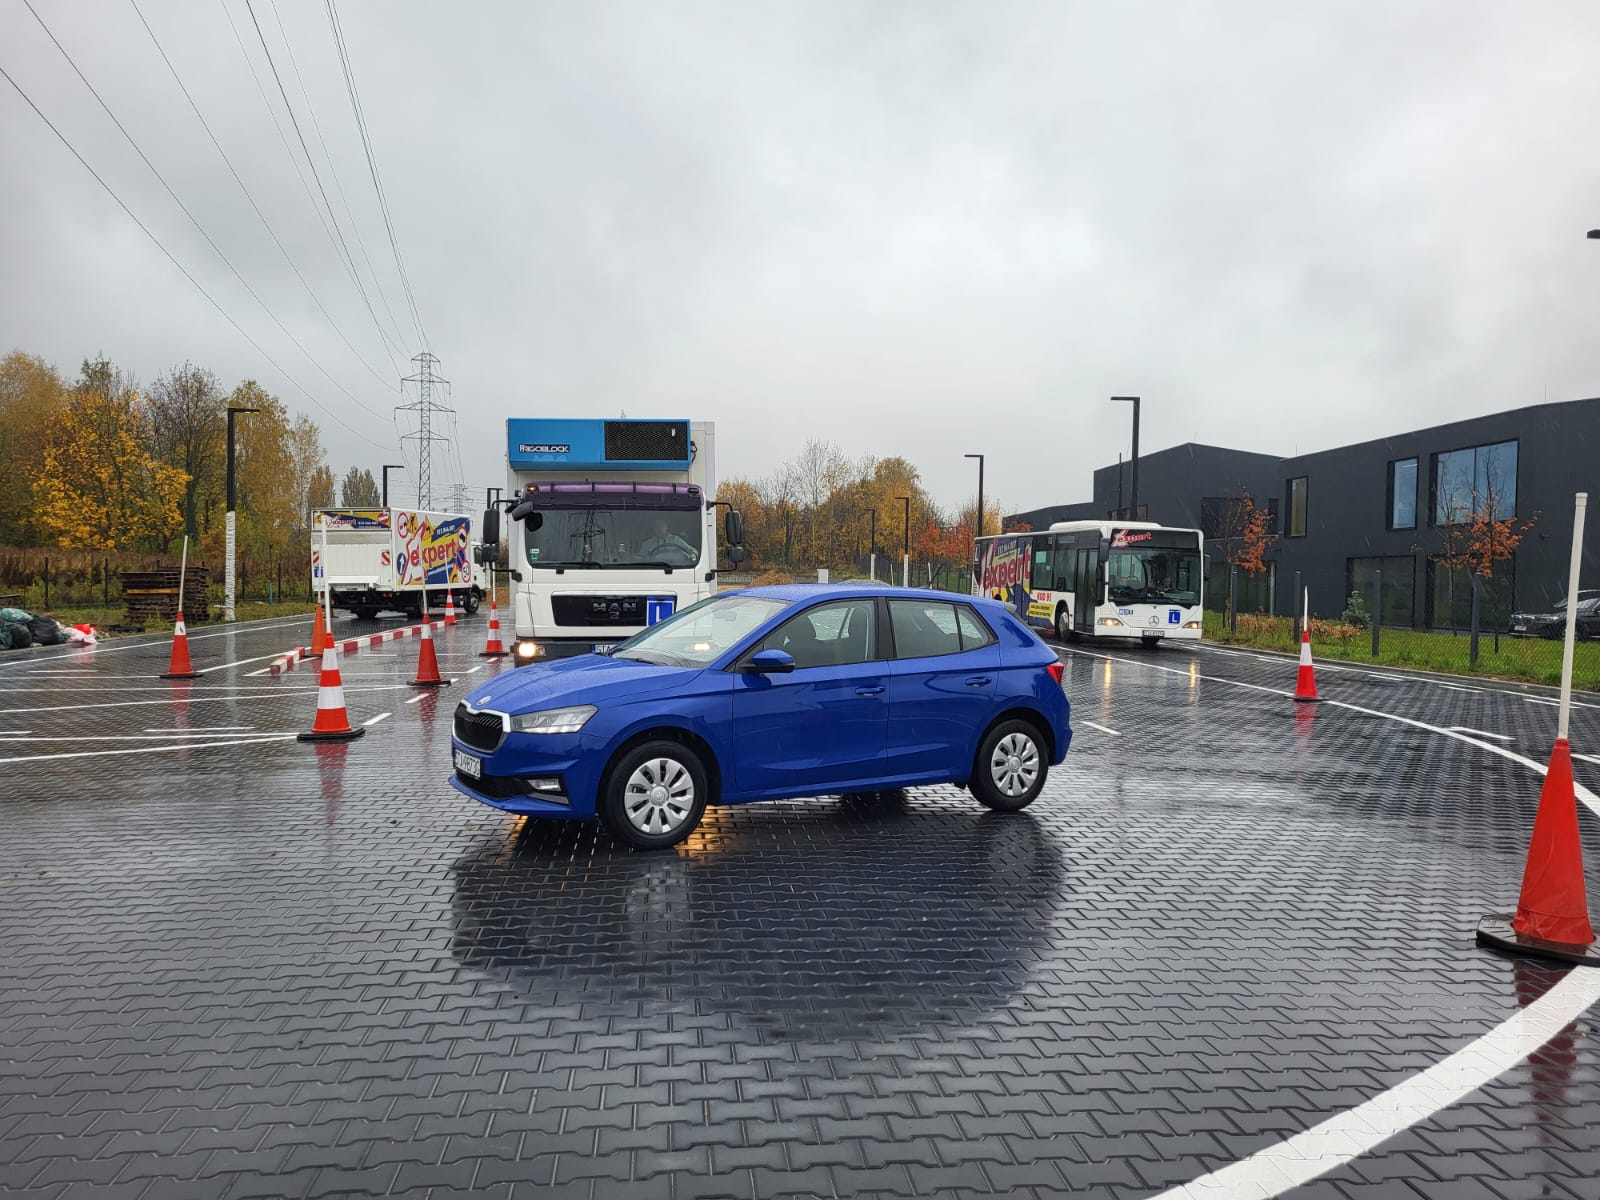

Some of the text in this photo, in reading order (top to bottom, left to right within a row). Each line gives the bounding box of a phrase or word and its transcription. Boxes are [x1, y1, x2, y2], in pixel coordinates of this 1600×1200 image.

[1118, 531, 1152, 543] expert
[410, 538, 457, 568] expert
[984, 545, 1031, 593] expert
[593, 602, 637, 612] MAN
[1172, 614, 1178, 623] L
